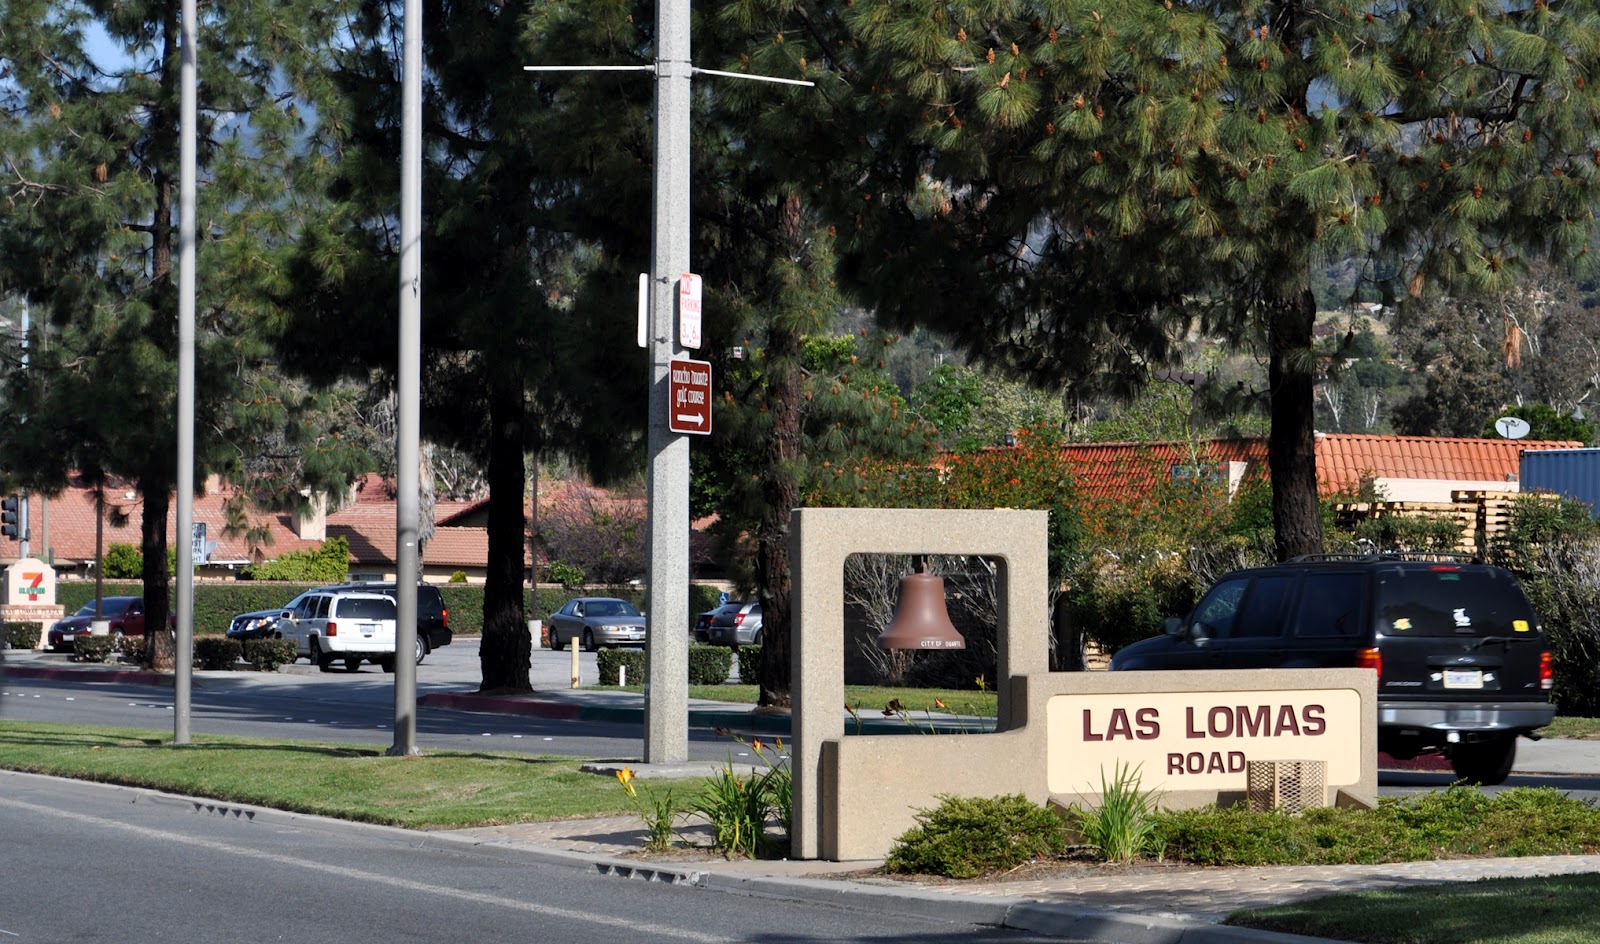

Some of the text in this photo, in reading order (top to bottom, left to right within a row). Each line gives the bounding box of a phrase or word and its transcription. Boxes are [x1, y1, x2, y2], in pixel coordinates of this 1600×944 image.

[682, 276, 691, 293] NO
[22, 572, 43, 601] 7
[1082, 704, 1327, 741] LAS LOMAS
[1166, 750, 1247, 775] ROAD
